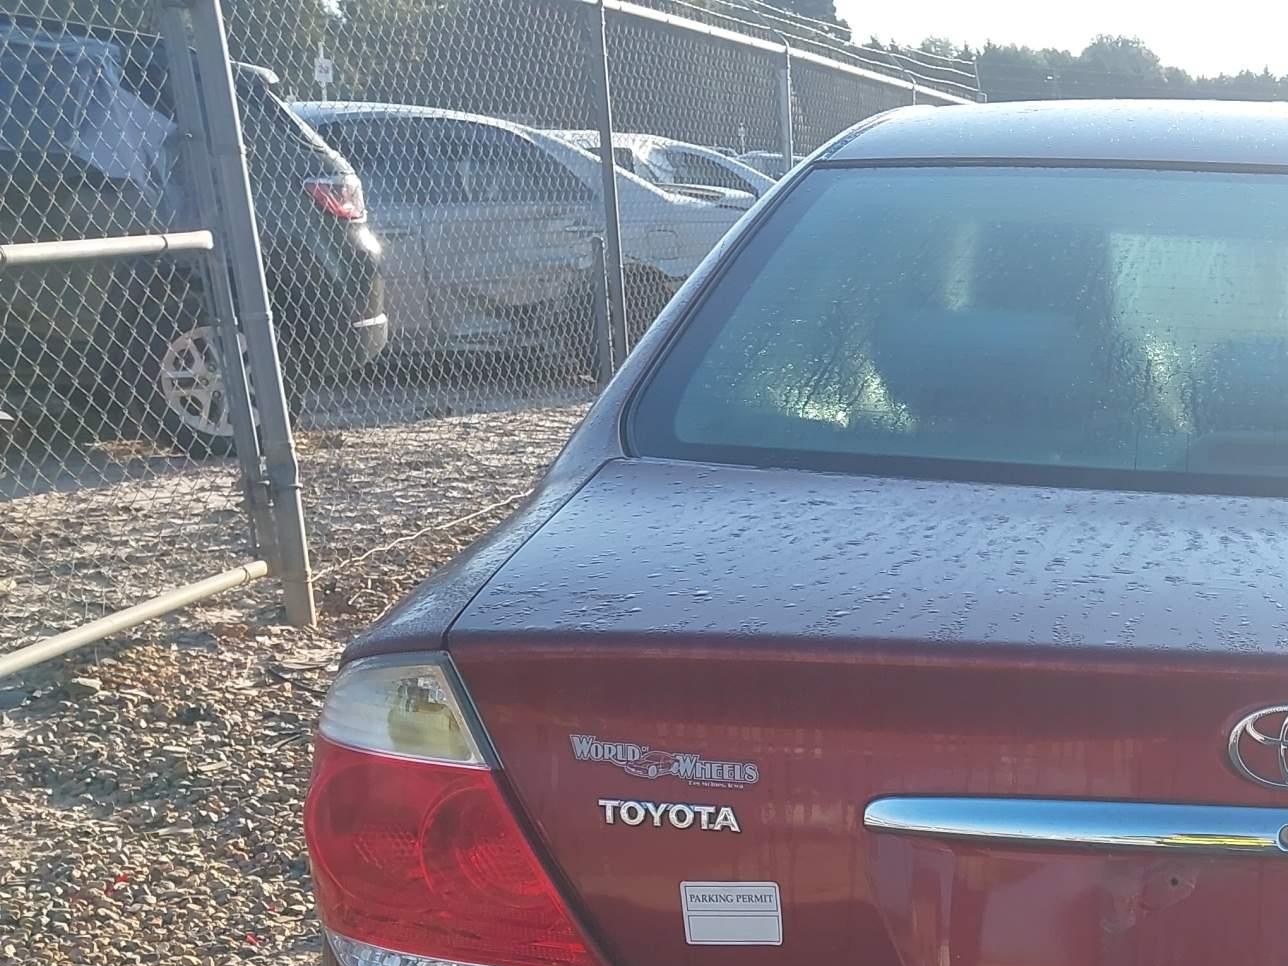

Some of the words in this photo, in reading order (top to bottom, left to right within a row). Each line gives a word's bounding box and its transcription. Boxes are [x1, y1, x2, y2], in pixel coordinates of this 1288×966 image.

[598, 799, 741, 832] TOYOTA
[689, 894, 734, 903] PARKING
[735, 894, 774, 903] PERMIT
